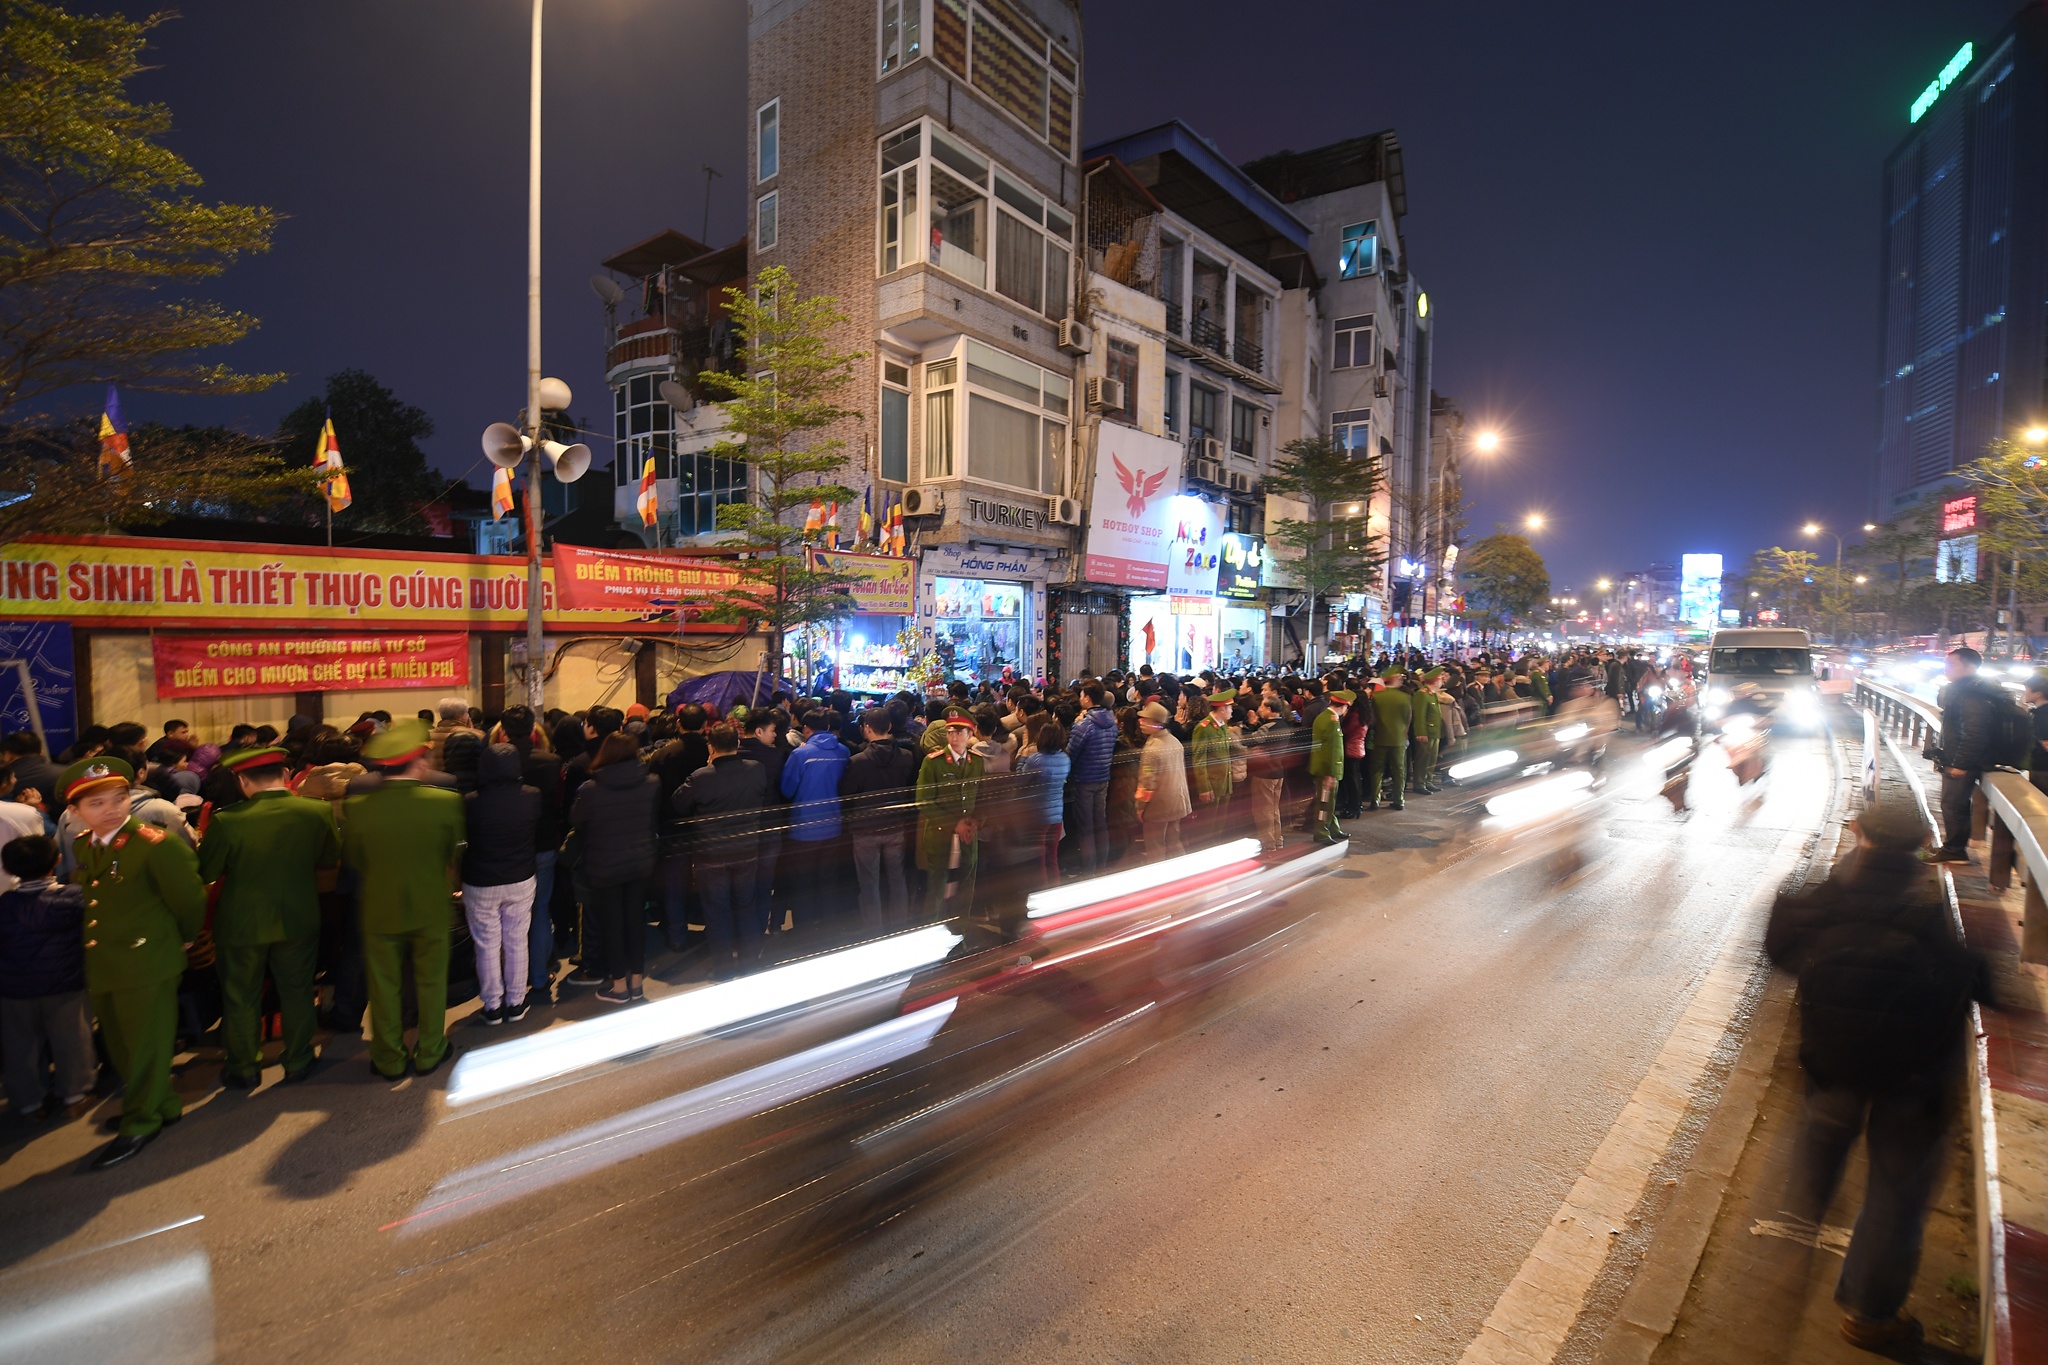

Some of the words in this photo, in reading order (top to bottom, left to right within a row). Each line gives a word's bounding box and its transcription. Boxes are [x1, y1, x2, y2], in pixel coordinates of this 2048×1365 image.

[969, 498, 1047, 530] TURKEY
[1103, 519, 1140, 534] HOTBOY
[1141, 526, 1163, 538] SHOP
[1176, 520, 1207, 541] Kis
[943, 547, 961, 561] Shop
[576, 559, 620, 581] ĐIỂM
[624, 565, 674, 583] TRÔNG
[704, 571, 720, 585] XE
[0, 560, 60, 602] NG
[67, 562, 156, 603] SINH
[162, 559, 203, 604] LÀ
[207, 562, 298, 606] THIẾT
[303, 571, 383, 616] THỰC
[389, 569, 464, 609] CÚNG
[207, 641, 253, 657] CÔNG
[258, 642, 280, 655] AN
[284, 638, 347, 655] PHƯỜNG
[351, 638, 382, 653] NGÃ
[385, 639, 403, 652] TƯ
[174, 661, 218, 688] ĐIỂM
[223, 666, 256, 686] CHO
[261, 663, 308, 687] MƯỢN
[346, 661, 368, 683] DỰ
[370, 656, 387, 679] LỄ
[391, 656, 428, 679] MIỄN
[431, 658, 455, 678] PHÍ
